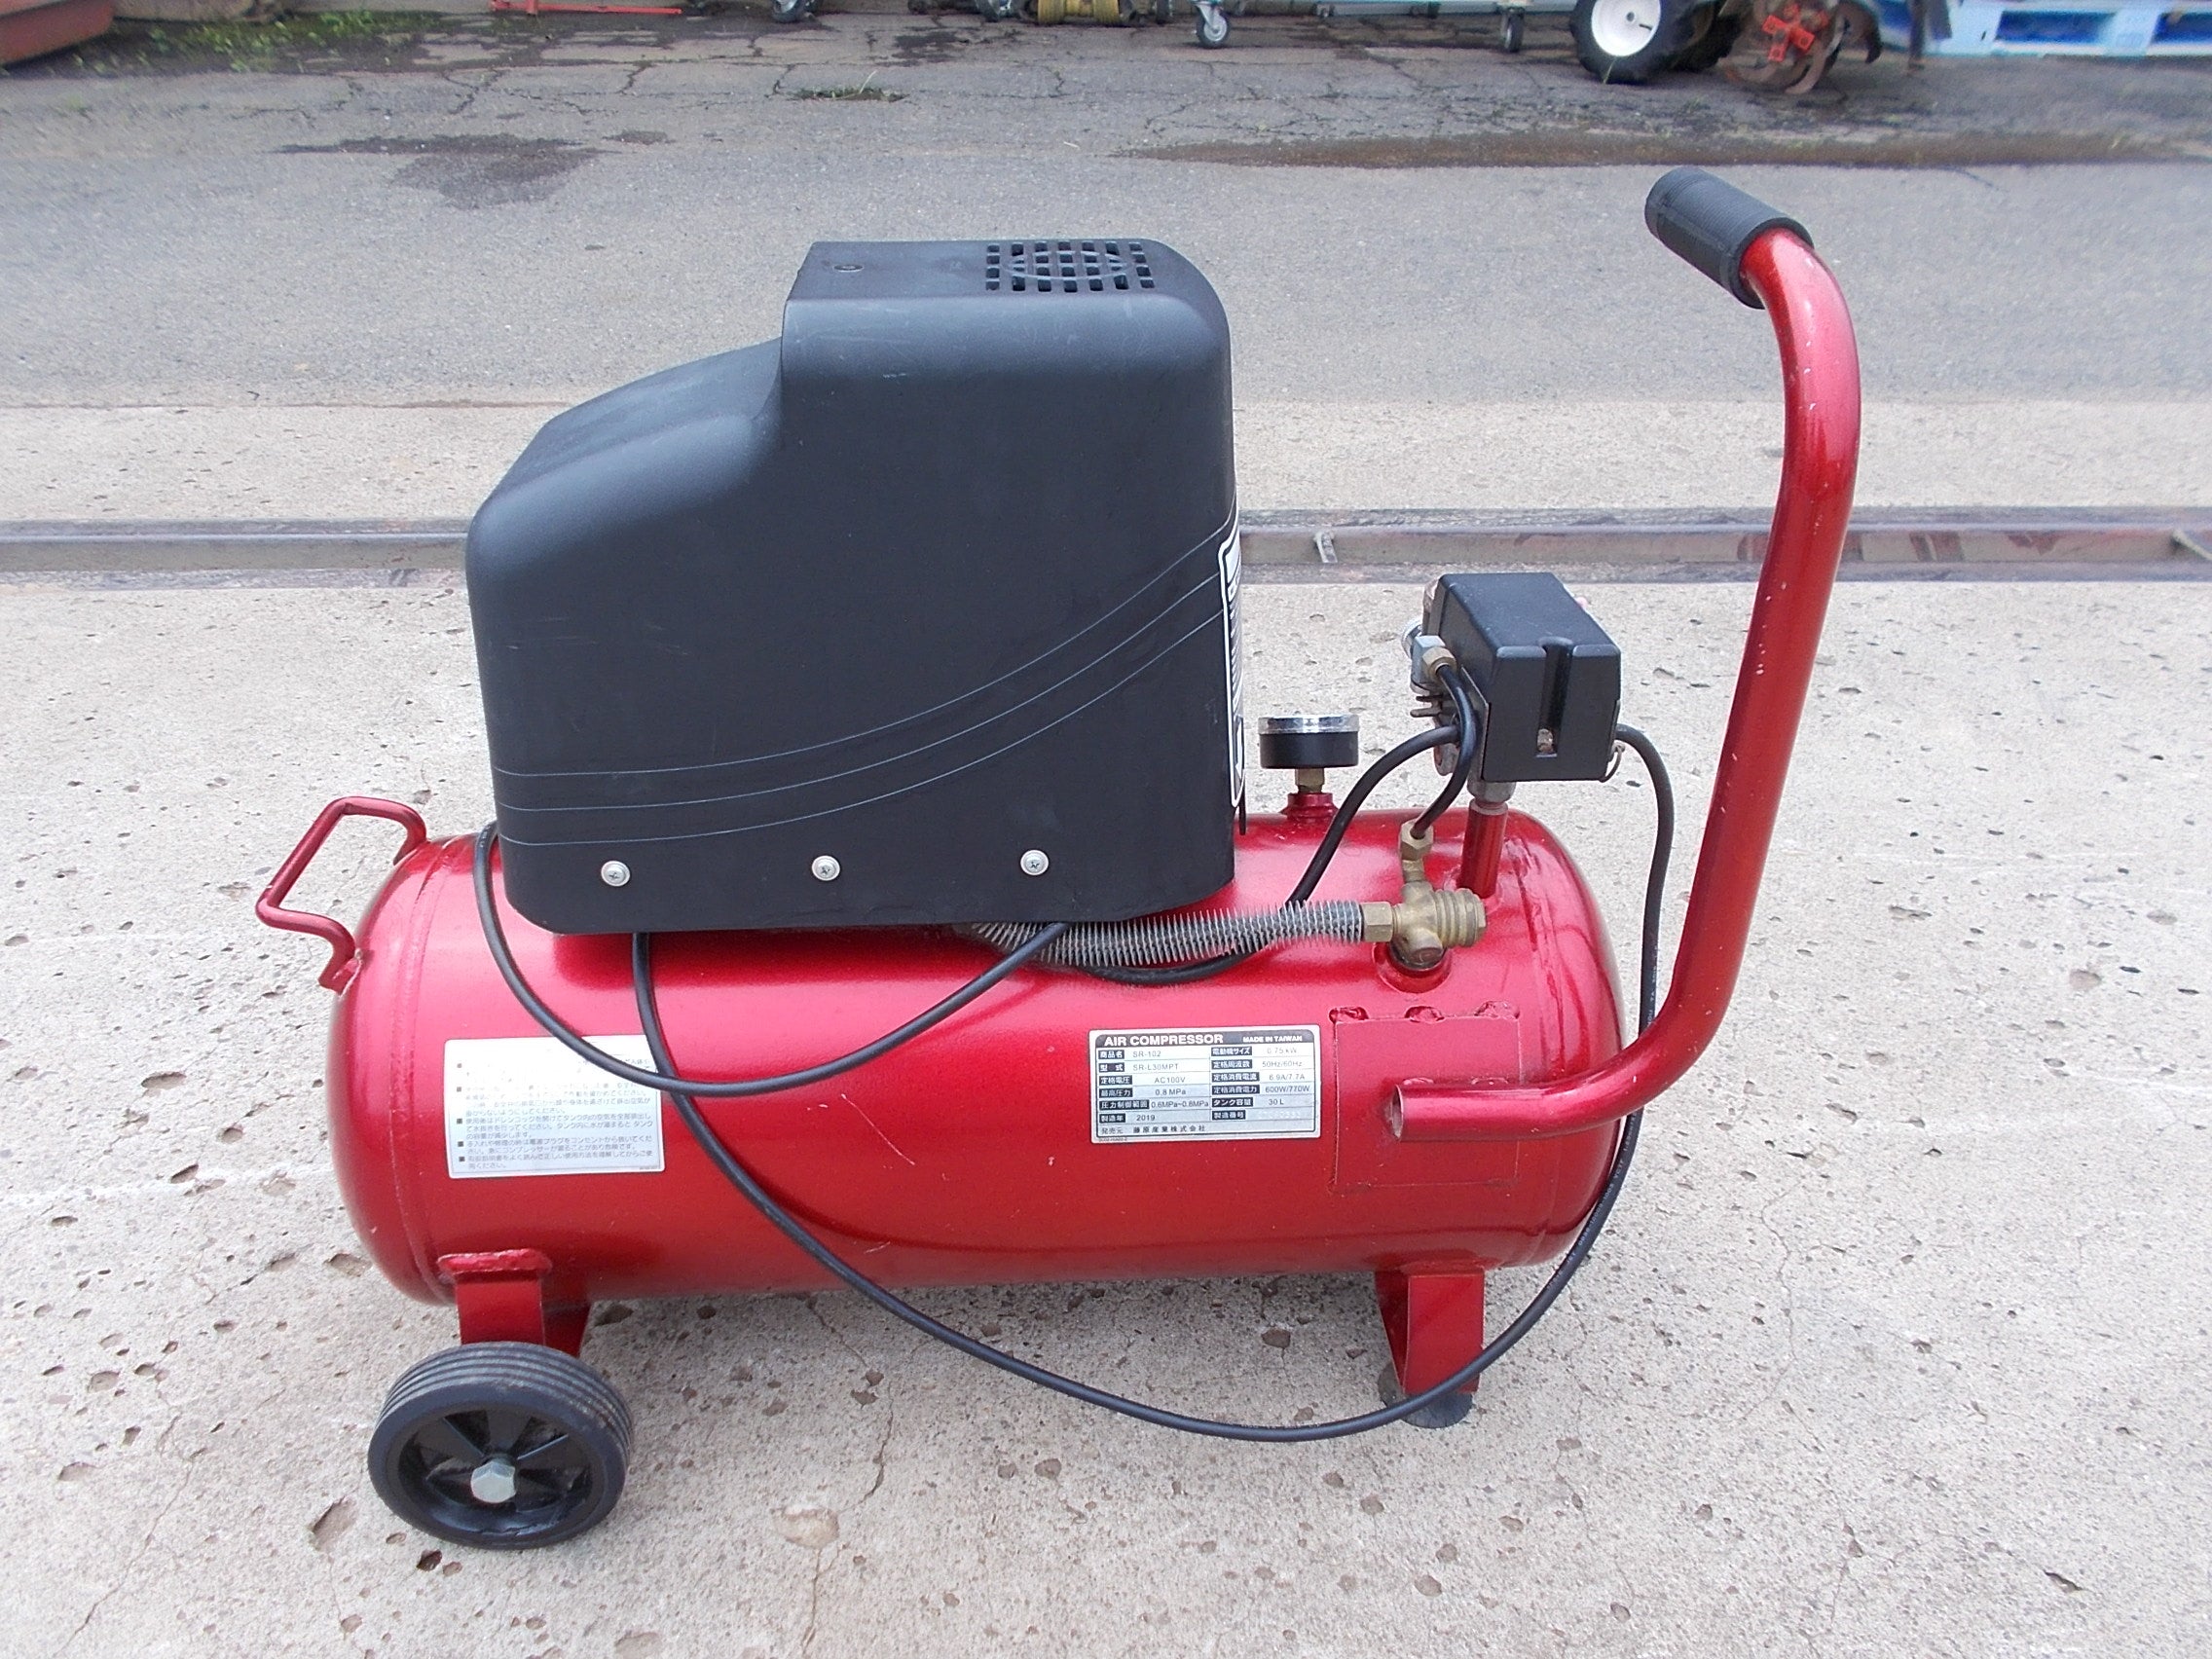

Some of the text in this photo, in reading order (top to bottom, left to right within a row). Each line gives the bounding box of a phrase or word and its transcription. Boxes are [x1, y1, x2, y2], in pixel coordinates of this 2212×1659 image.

[1104, 1034, 1224, 1046] AIR COMPRESSOR
[1099, 1051, 1124, 1059] 商品名
[1101, 1114, 1124, 1123] 製造年
[1213, 1111, 1244, 1120] 製造番号
